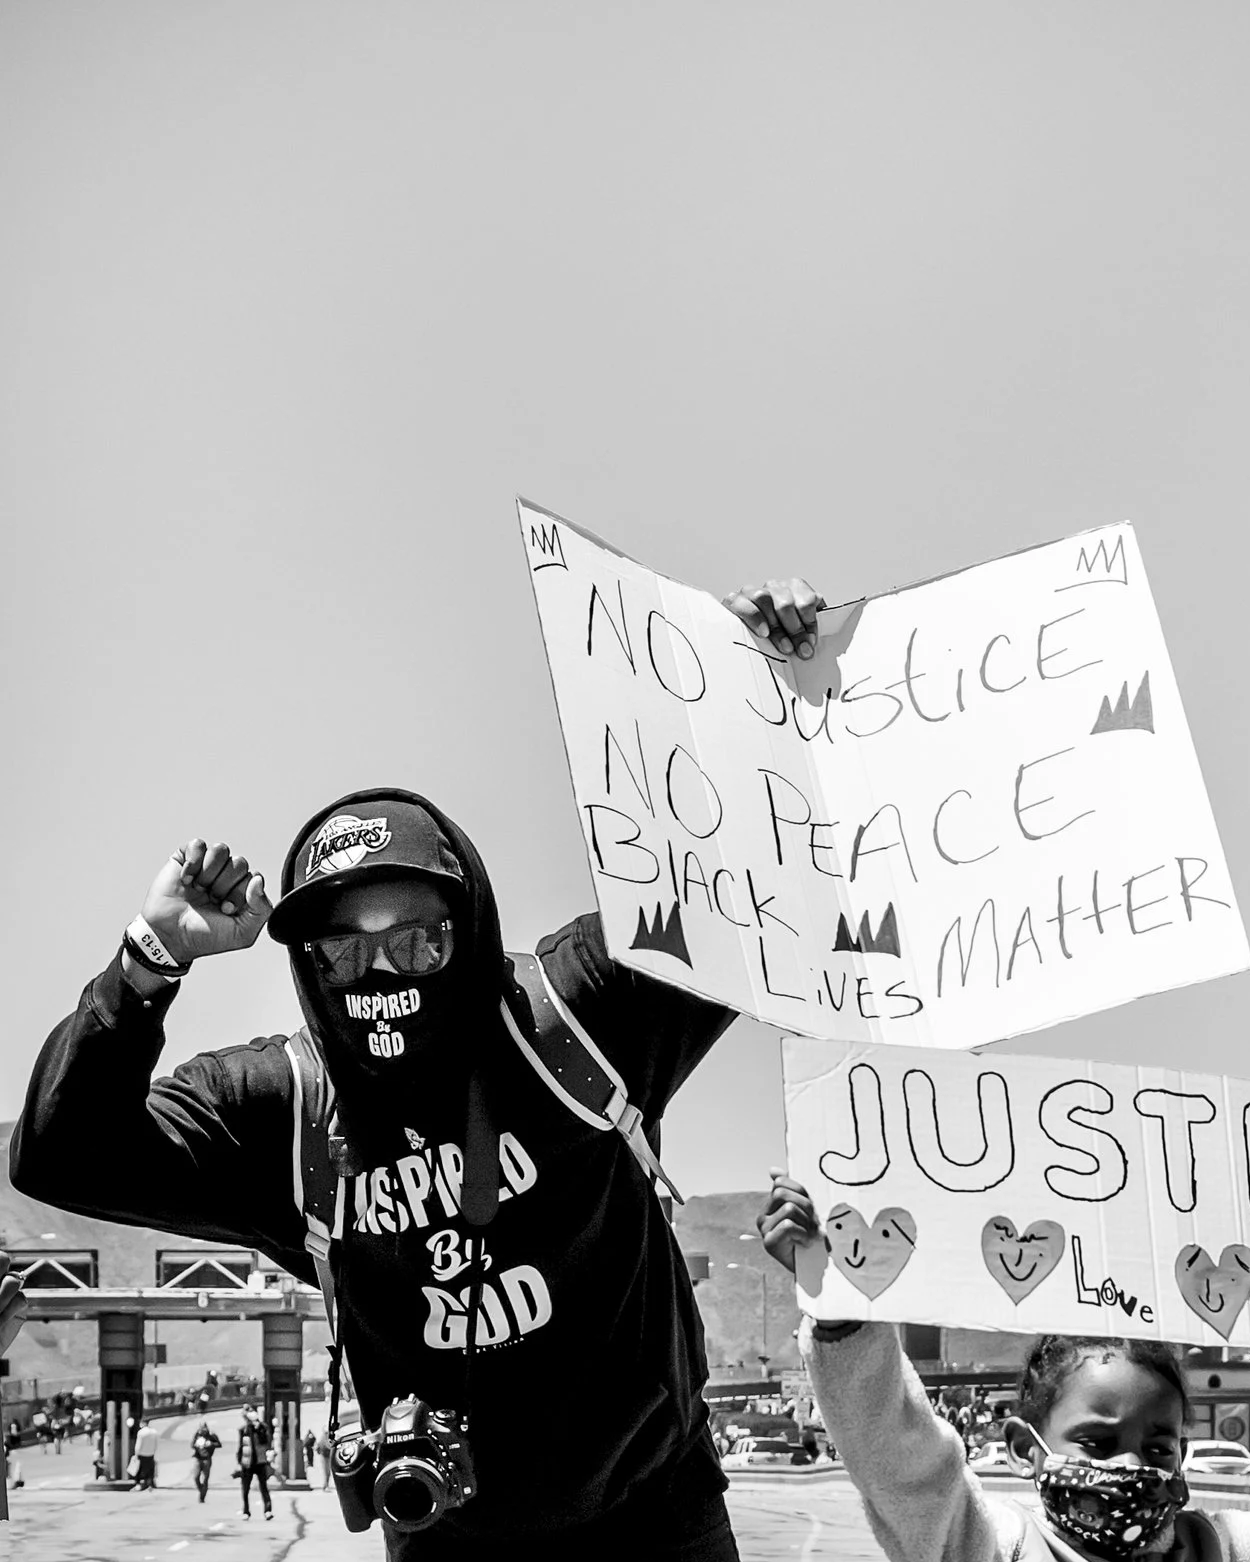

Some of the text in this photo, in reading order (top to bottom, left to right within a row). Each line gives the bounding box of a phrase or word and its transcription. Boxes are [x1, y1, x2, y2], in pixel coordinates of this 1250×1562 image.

[587, 580, 706, 702] NO
[604, 719, 1097, 883] NO PEACE
[306, 826, 390, 877] LAKERS
[141, 934, 164, 961] 15:13
[345, 988, 420, 1020] INSPIRED
[368, 1031, 405, 1058] GOD
[330, 1131, 538, 1240] INSPIRD
[422, 1265, 552, 1349] GOD
[1071, 1235, 1154, 1323] Love
[386, 1433, 415, 1444] Nikon
